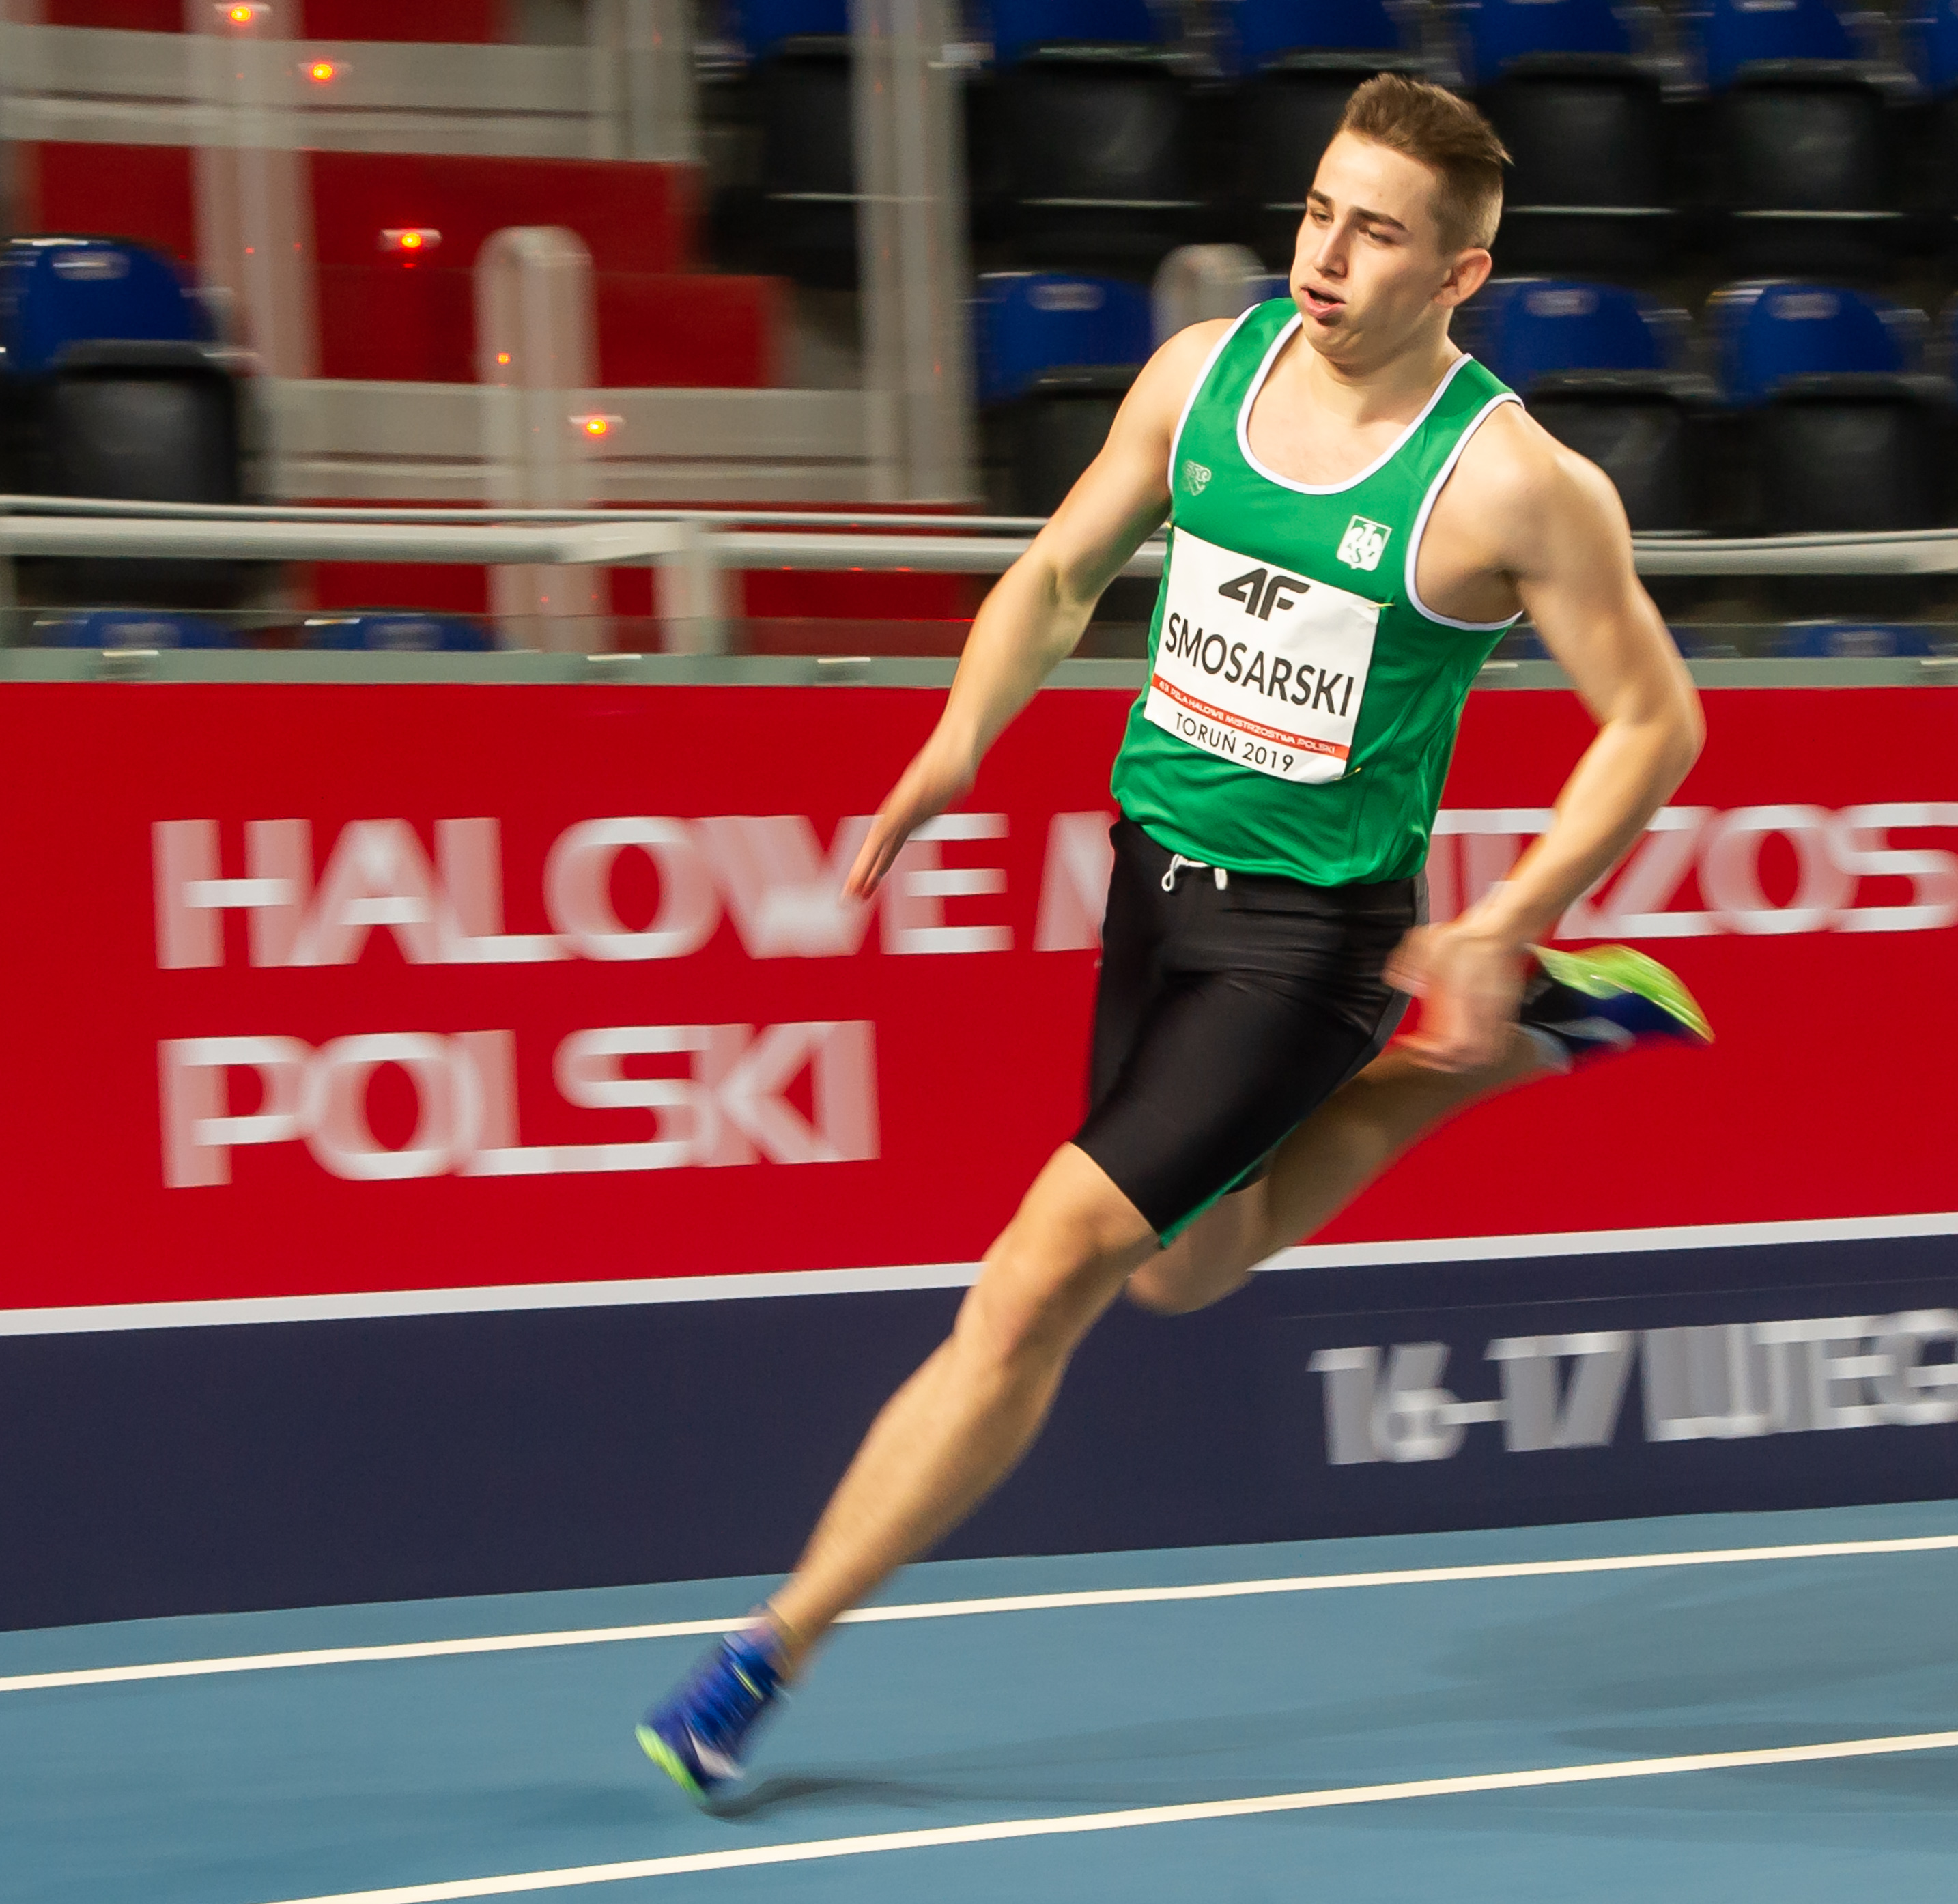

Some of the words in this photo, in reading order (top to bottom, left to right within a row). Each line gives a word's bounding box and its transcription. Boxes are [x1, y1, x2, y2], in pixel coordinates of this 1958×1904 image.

[1218, 567, 1311, 621] 4F
[1165, 612, 1354, 717] SMOSARSKI
[1176, 711, 1236, 754] TORUŃ
[1242, 742, 1294, 772] 2019
[1225, 714, 1296, 744] MISTRZOSTWA
[1297, 737, 1336, 754] POLSKI
[152, 814, 1013, 969] HALOWE
[157, 1019, 881, 1189] POLSKI
[1307, 1330, 1636, 1465] 16-17
